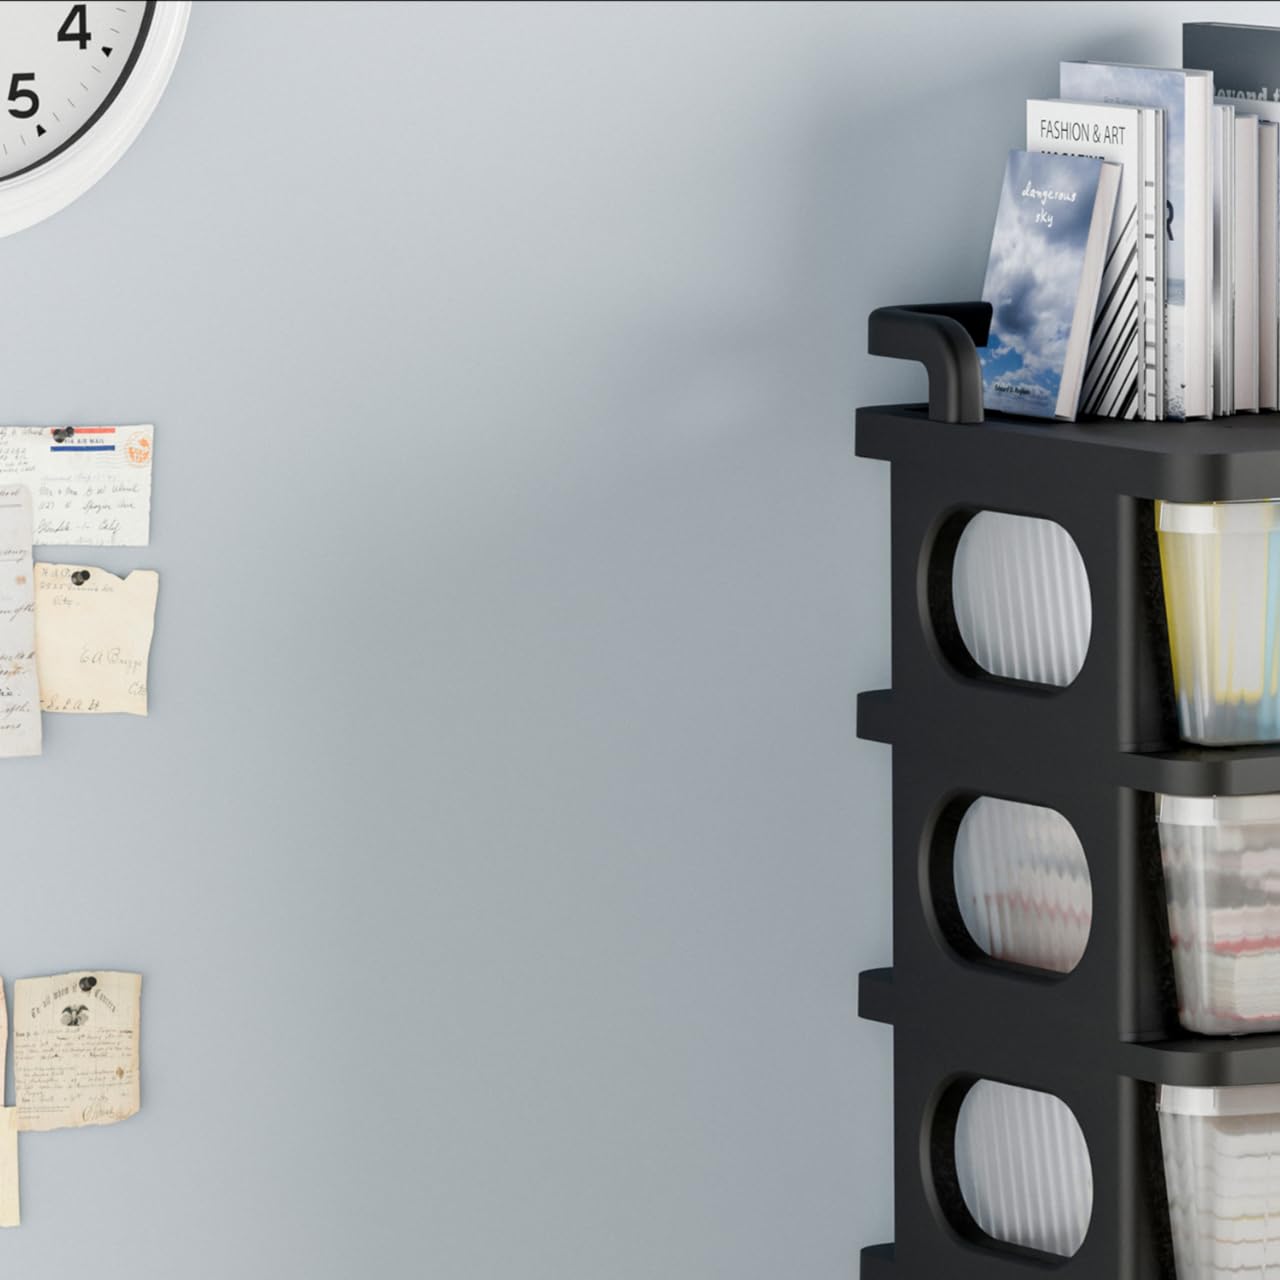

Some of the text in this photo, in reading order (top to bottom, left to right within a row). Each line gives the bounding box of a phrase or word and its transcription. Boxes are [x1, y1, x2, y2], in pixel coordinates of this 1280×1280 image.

[57, 4, 92, 50] 4
[7, 72, 40, 119] 5
[1040, 119, 1126, 145] FASHION & ART
[1021, 181, 1078, 205] dangerous
[1034, 207, 1054, 228] sky
